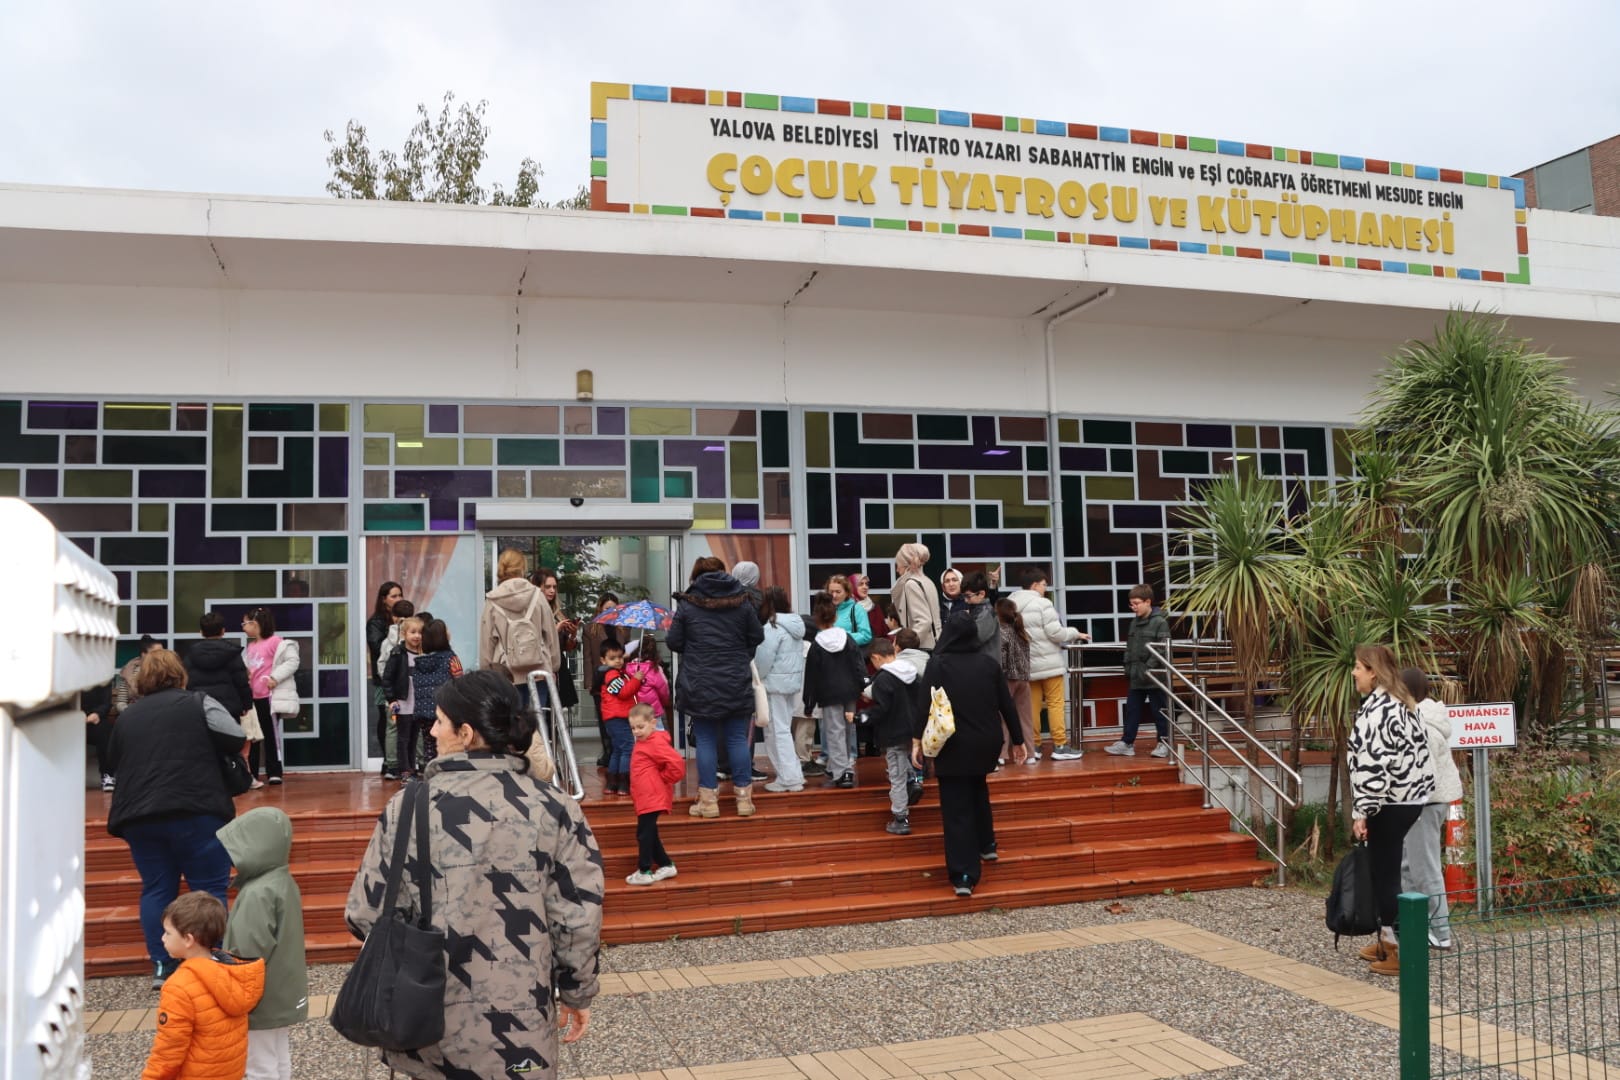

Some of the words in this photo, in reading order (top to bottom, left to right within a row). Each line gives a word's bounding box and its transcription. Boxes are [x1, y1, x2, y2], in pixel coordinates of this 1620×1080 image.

[710, 117, 776, 142] YALOVA
[783, 124, 879, 150] BELEDİYESİ
[892, 130, 960, 157] TİYATRO
[964, 139, 1021, 162] YAZARI
[1028, 146, 1126, 173] SABAHATTİN
[1132, 156, 1174, 178] ENGİN
[1178, 165, 1195, 180] ve
[1199, 163, 1222, 187] EŞİ
[1226, 166, 1296, 191] COĞRAFYA
[1300, 172, 1372, 200] ÖĞRETMENİ
[1375, 184, 1424, 206] MESUDE
[1427, 191, 1464, 210] ENGİN
[706, 152, 878, 206] ÇOCUK
[890, 157, 1138, 223] TİYATROSU
[1197, 188, 1455, 255] KÜTÜPHANESİ
[1448, 707, 1510, 718] DUMANSIZ
[1464, 722, 1496, 731] HAVA
[1458, 735, 1502, 745] SAHASI
